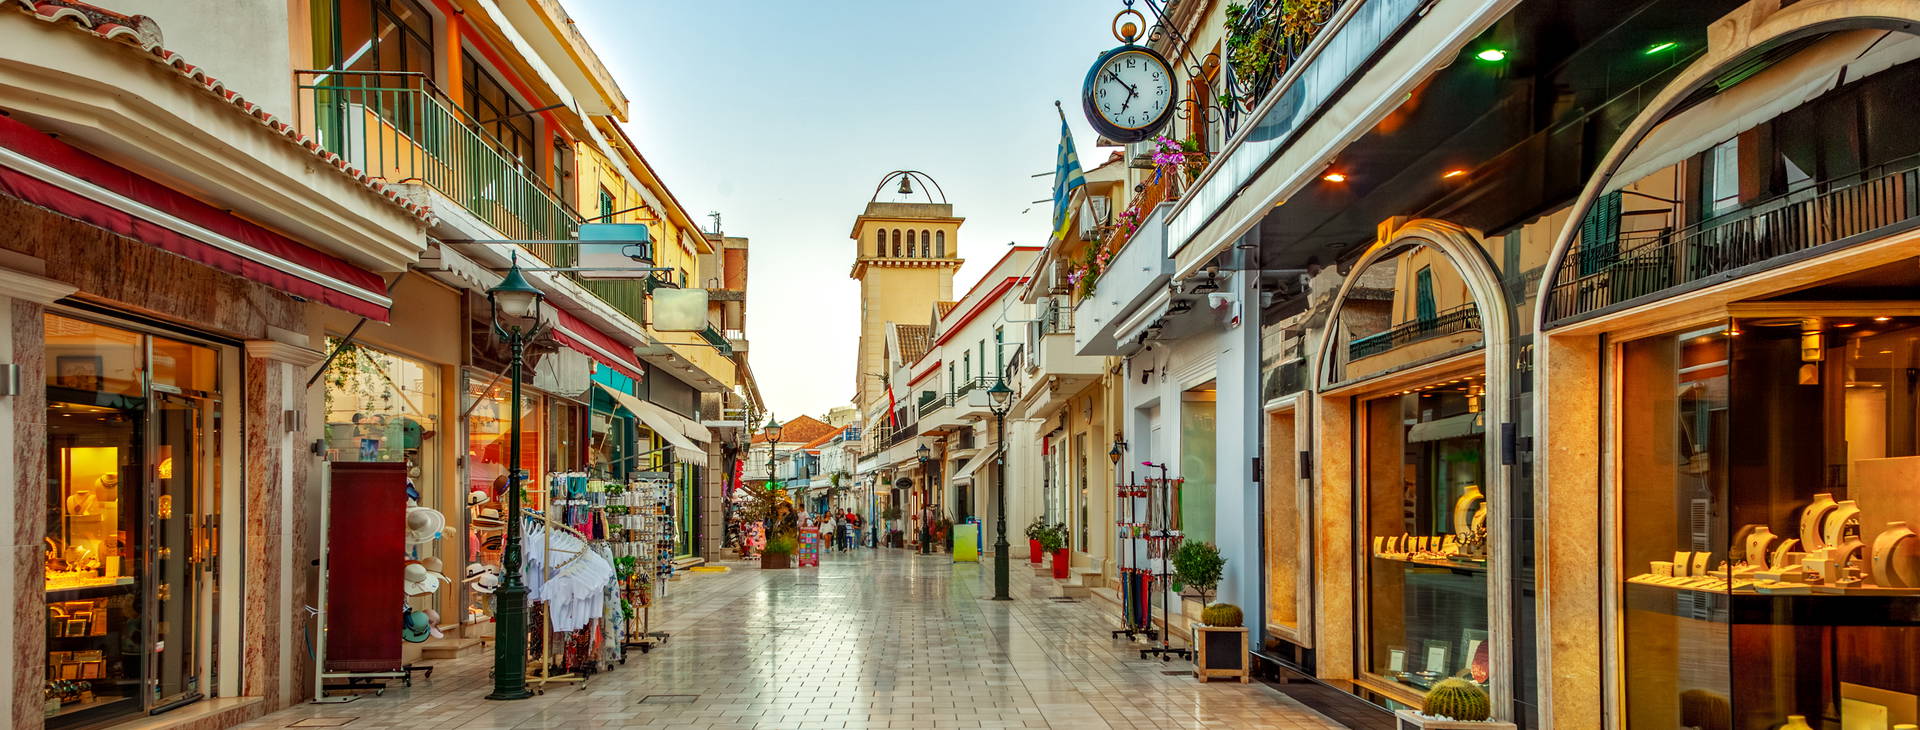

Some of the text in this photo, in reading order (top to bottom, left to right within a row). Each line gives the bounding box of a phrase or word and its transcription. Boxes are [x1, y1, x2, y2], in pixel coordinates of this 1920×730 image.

[1115, 63, 1121, 72] 11
[1126, 59, 1136, 68] 12
[1103, 75, 1111, 84] 10
[1152, 72, 1159, 81] 2
[1100, 88, 1106, 98] 9
[1104, 103, 1110, 112] 8
[1114, 113, 1121, 122] 7
[1128, 116, 1135, 125] 6
[1142, 111, 1149, 121] 5
